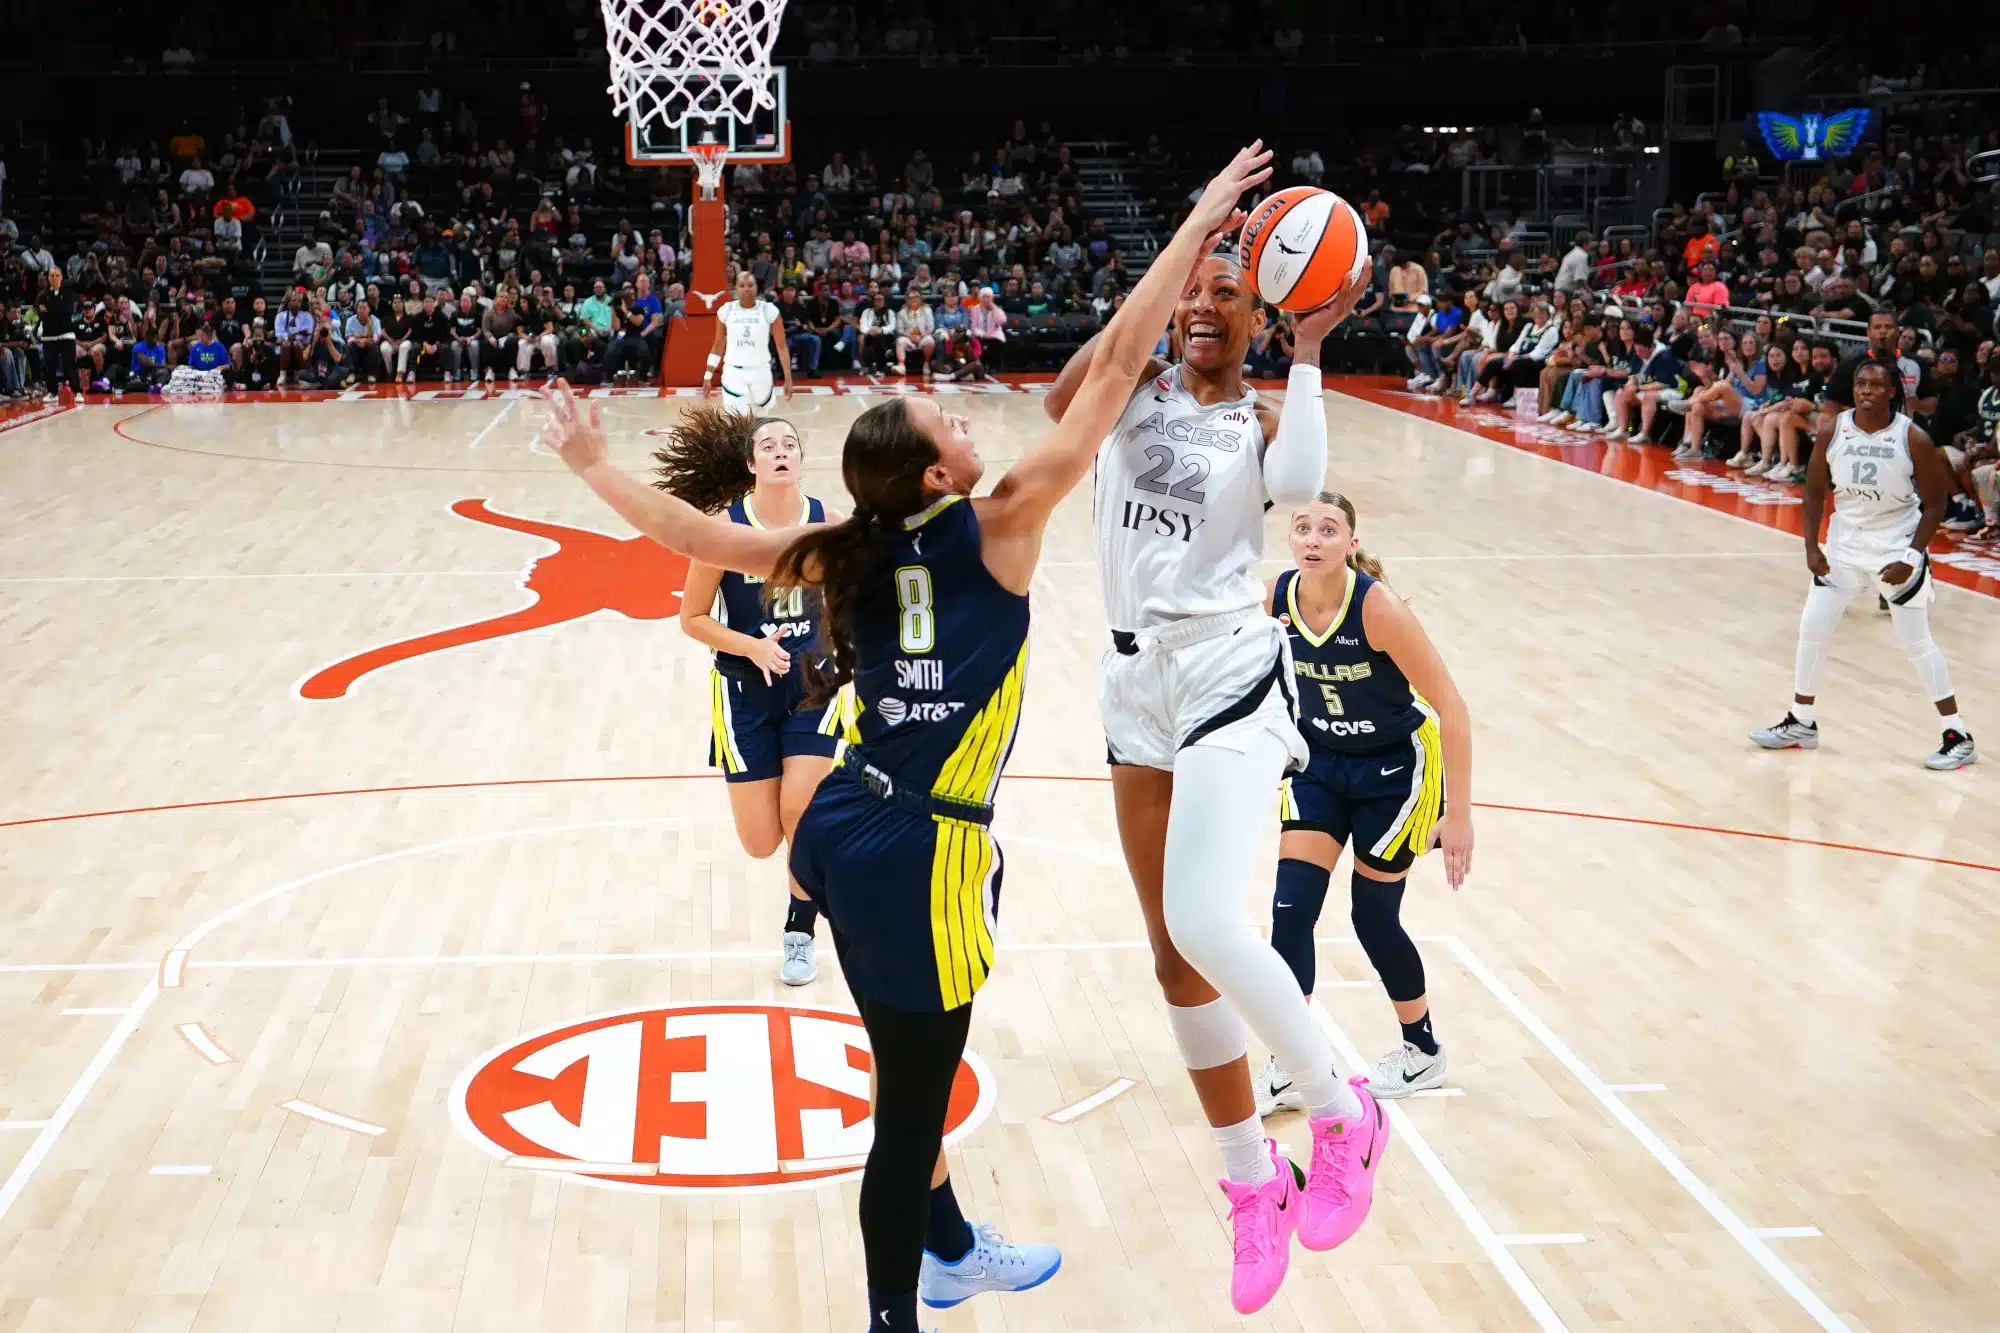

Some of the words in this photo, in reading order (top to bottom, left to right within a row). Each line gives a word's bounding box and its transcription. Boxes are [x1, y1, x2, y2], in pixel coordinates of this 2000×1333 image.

[1240, 199, 1288, 271] Wilson
[1136, 411, 1242, 453] ACES
[1223, 411, 1250, 425] ally
[1844, 444, 1894, 459] ACES
[1134, 444, 1211, 505] 22
[1851, 461, 1878, 486] 12
[1122, 500, 1206, 542] IPSY
[772, 584, 804, 619] 20
[895, 565, 935, 654] 8
[778, 620, 811, 638] CVS
[1335, 635, 1359, 646] Albert
[894, 659, 943, 691] SMITH
[1293, 660, 1372, 681] ALLAS
[905, 702, 965, 722] AT&T
[1319, 683, 1344, 716] 5
[1330, 720, 1376, 736] CVS
